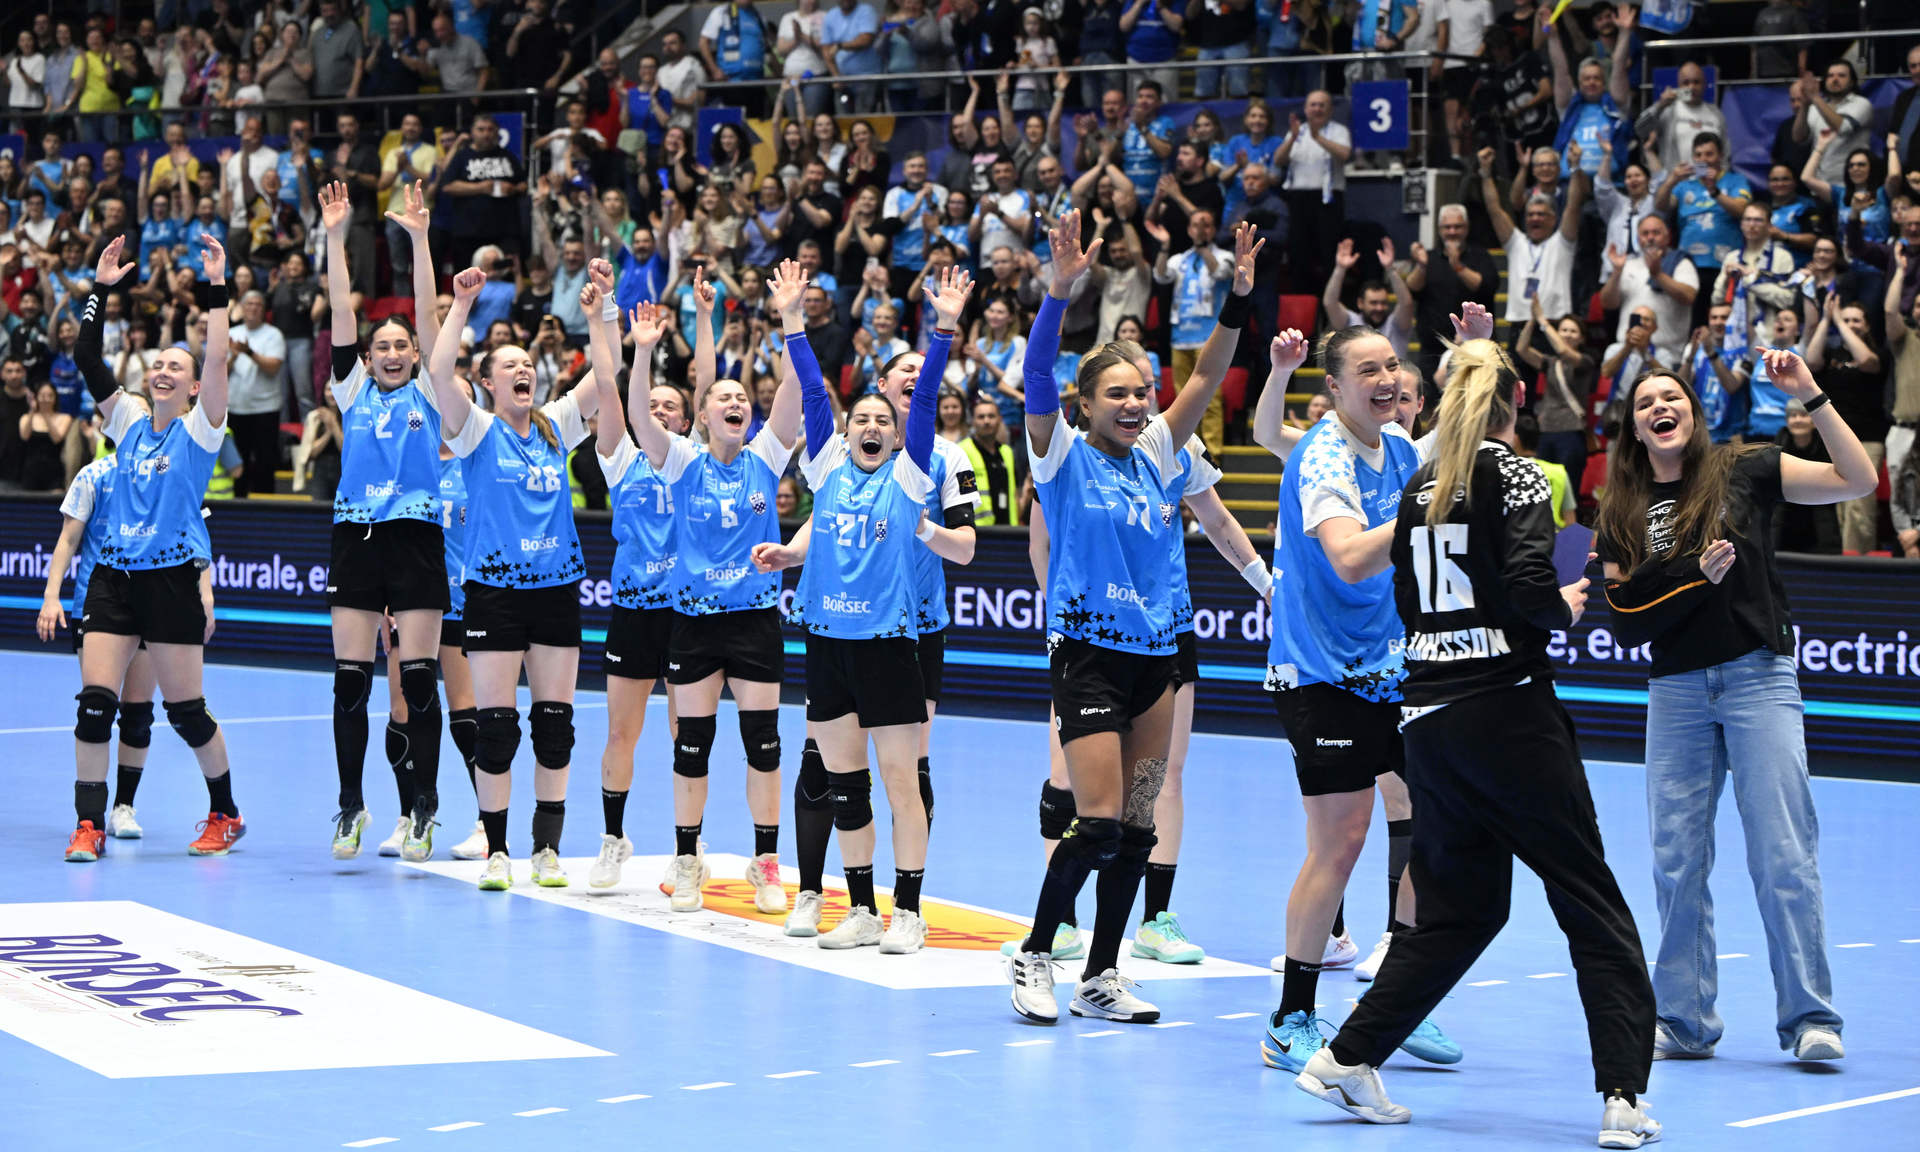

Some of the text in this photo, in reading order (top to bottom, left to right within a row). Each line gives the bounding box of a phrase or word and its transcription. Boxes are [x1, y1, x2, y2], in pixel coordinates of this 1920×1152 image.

[1369, 98, 1392, 133] 3
[375, 409, 393, 439] 2
[526, 465, 562, 492] 28
[721, 499, 738, 528] 5
[1125, 495, 1153, 535] 17
[520, 536, 560, 552] BOSEC
[0, 543, 82, 579] urnizr
[1409, 523, 1476, 614] 16
[822, 595, 872, 614] BORSEC
[954, 586, 1044, 630] ENGI
[1193, 608, 1235, 639] or
[681, 743, 700, 753] SELECT
[1316, 737, 1353, 749] Kempa
[0, 934, 304, 1023] BORSEC
